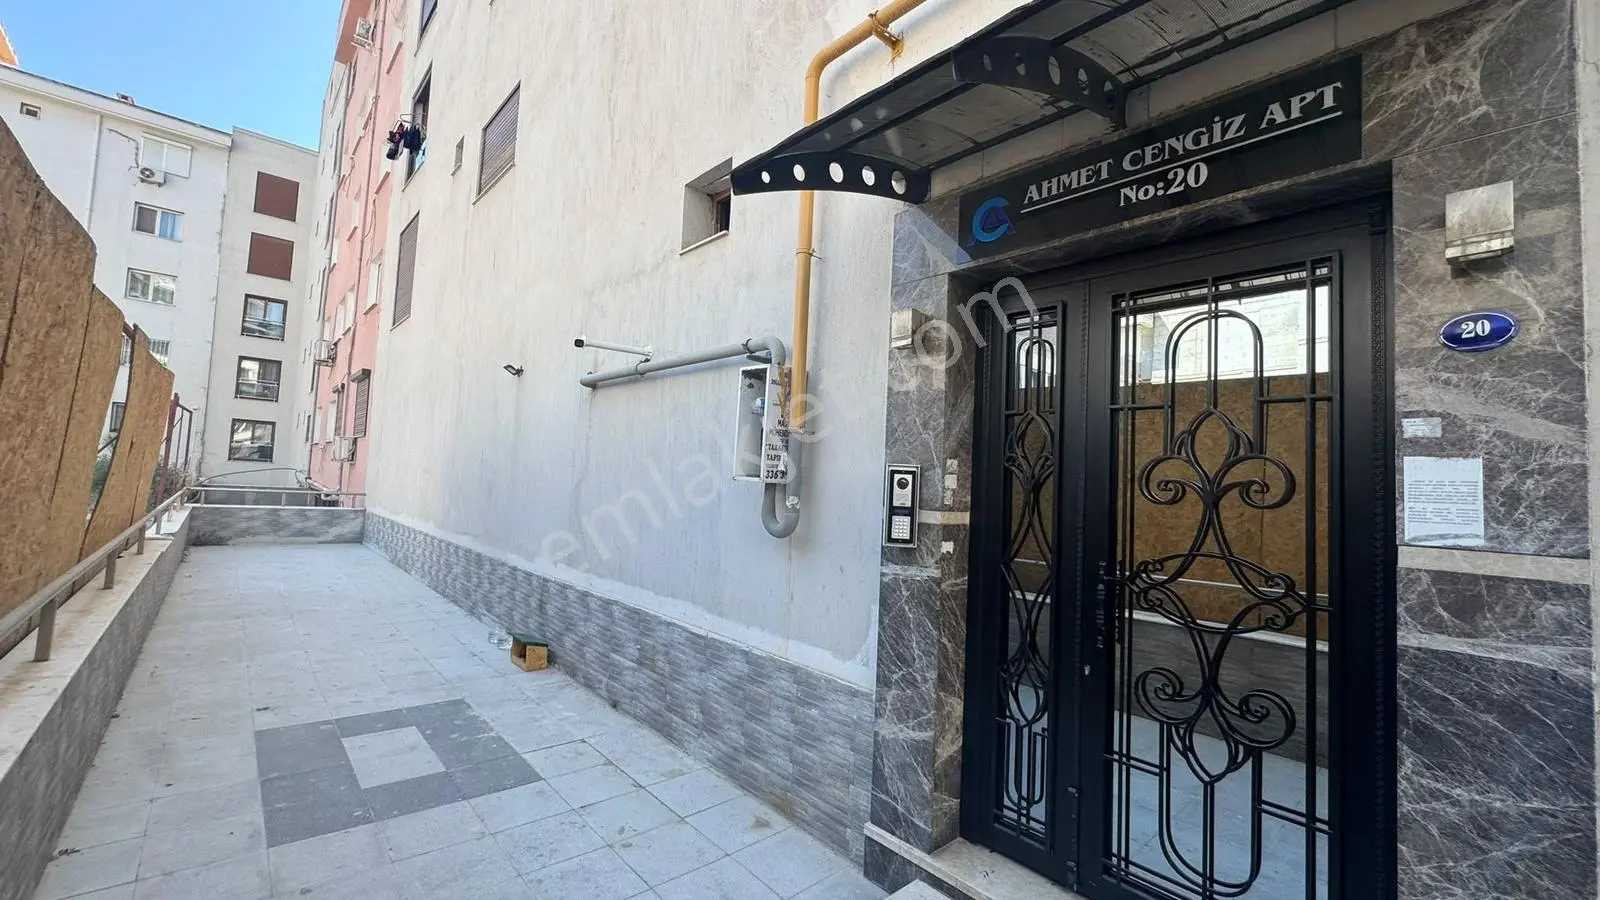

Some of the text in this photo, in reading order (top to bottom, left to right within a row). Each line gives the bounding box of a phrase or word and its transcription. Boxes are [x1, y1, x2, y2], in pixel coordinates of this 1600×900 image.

[1022, 82, 1342, 204] AHMET CENGİZ APT
[1118, 161, 1208, 207] No:20
[1460, 319, 1491, 339] 20
